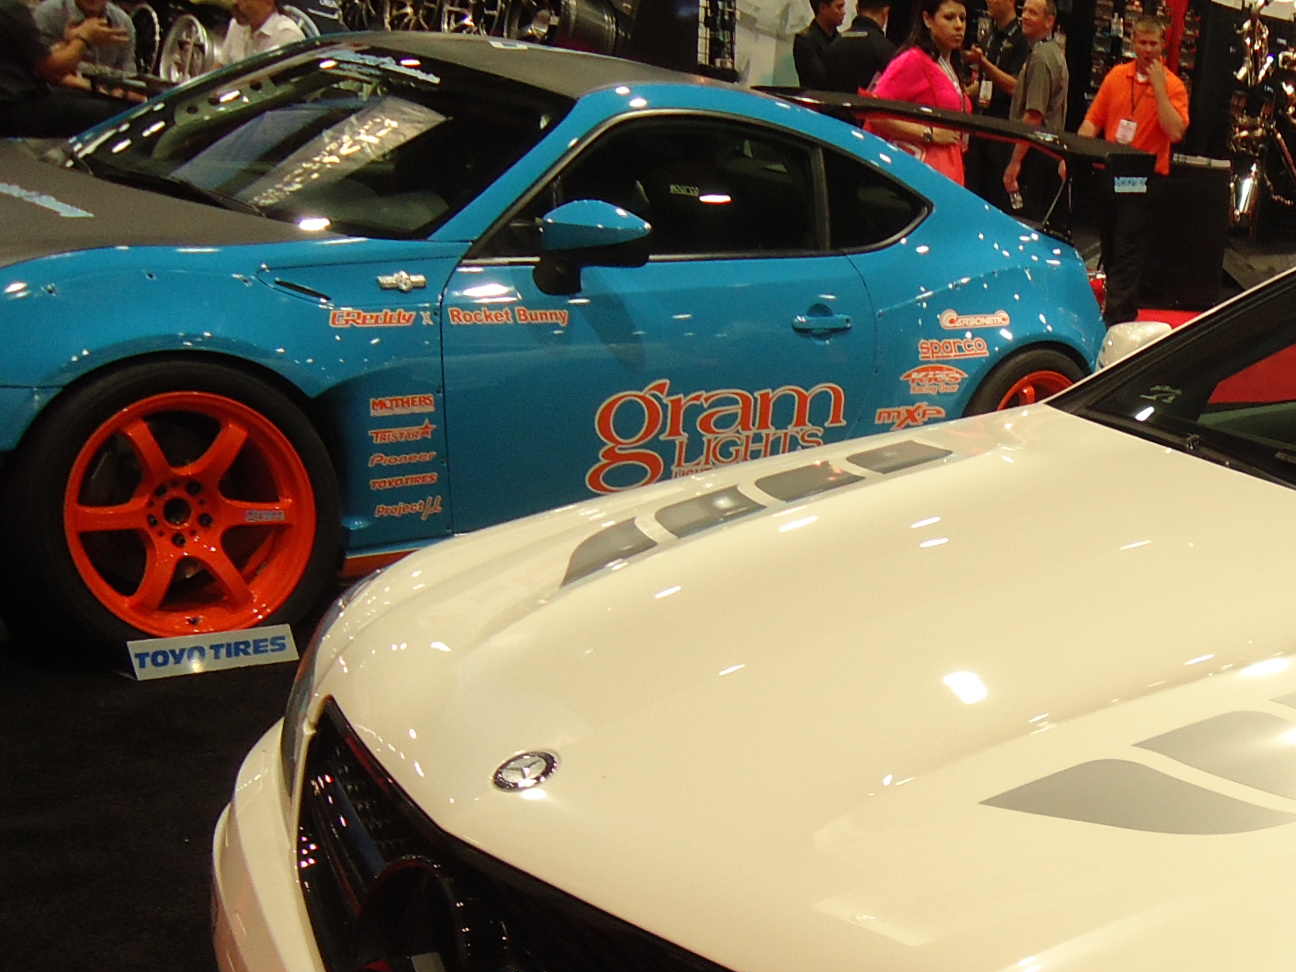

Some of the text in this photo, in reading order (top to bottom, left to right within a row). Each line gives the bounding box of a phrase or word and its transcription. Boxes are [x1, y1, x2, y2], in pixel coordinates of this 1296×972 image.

[330, 308, 416, 327] GReddy
[448, 306, 514, 325] Rocket
[515, 307, 569, 328] Bunny
[918, 338, 990, 361] sparco
[370, 394, 435, 412] MOTHERS
[585, 379, 847, 495] gram
[368, 452, 437, 467] Pioneer
[672, 427, 825, 470] LIGHTS
[370, 472, 438, 490] TOYO TIRES
[135, 635, 287, 669] TOYO TIRES
